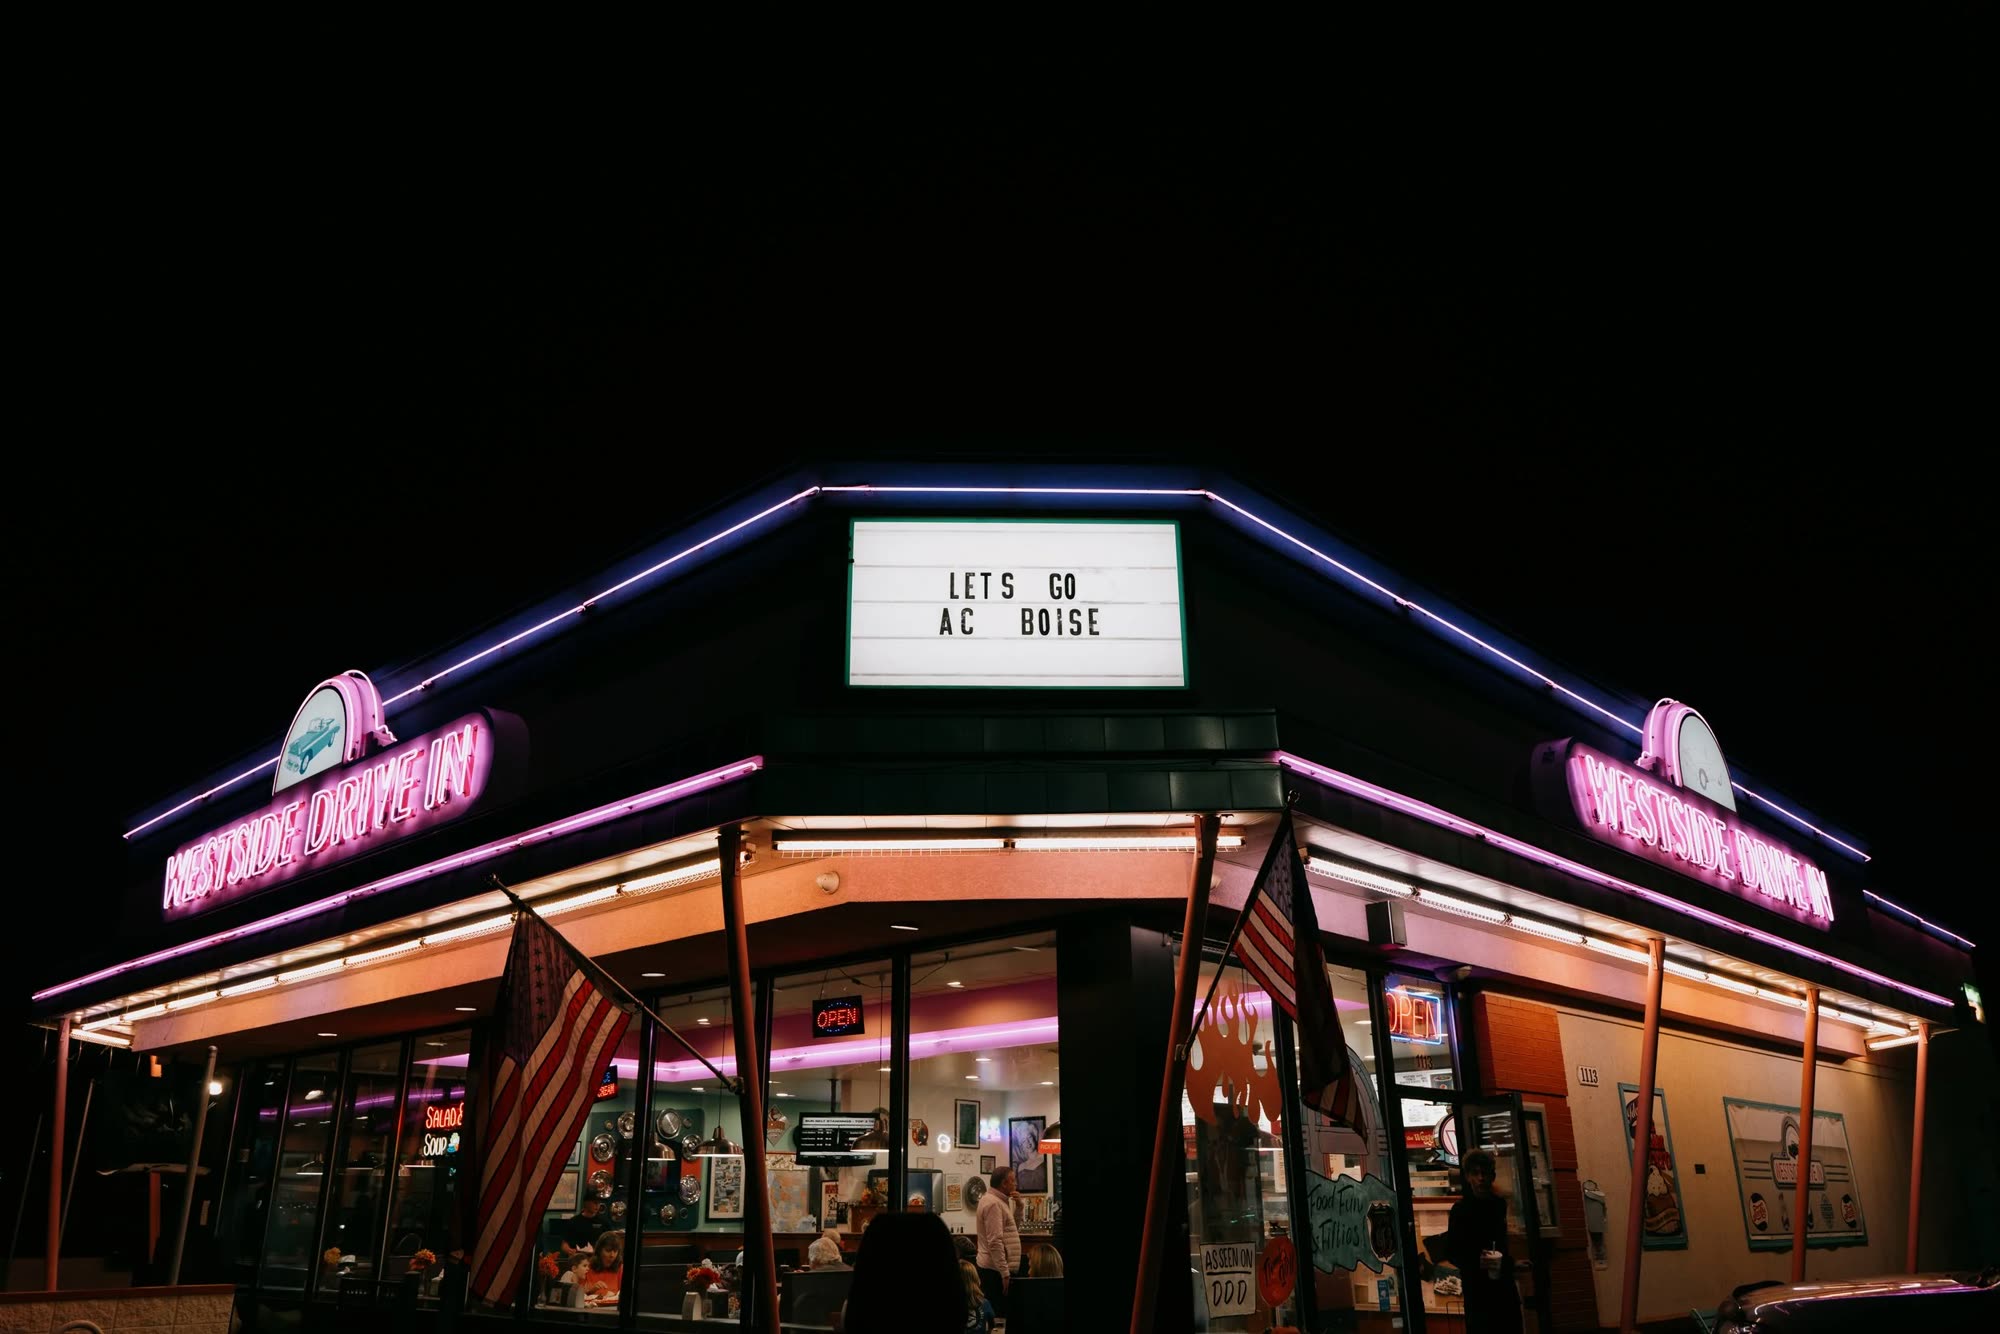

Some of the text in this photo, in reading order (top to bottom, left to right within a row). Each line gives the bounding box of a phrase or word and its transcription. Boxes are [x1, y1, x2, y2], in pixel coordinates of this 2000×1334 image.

[949, 572, 1077, 600] LETS GO
[939, 608, 1100, 636] AC BOISE
[163, 724, 475, 910] WESTSIDE DRIVE IN
[1585, 754, 1835, 921] WESTSIDE DRIVE IN
[817, 1007, 856, 1028] OPEN
[1386, 992, 1438, 1039] OPEN
[1415, 1054, 1432, 1069] 1113
[1580, 1067, 1598, 1083] 1113
[425, 1106, 456, 1129] SALAD
[423, 1133, 447, 1156] SOUP
[1307, 1184, 1362, 1218] Food Fun
[1206, 1249, 1219, 1271] AS
[1219, 1247, 1238, 1268] SEEN
[1240, 1249, 1253, 1268] ON
